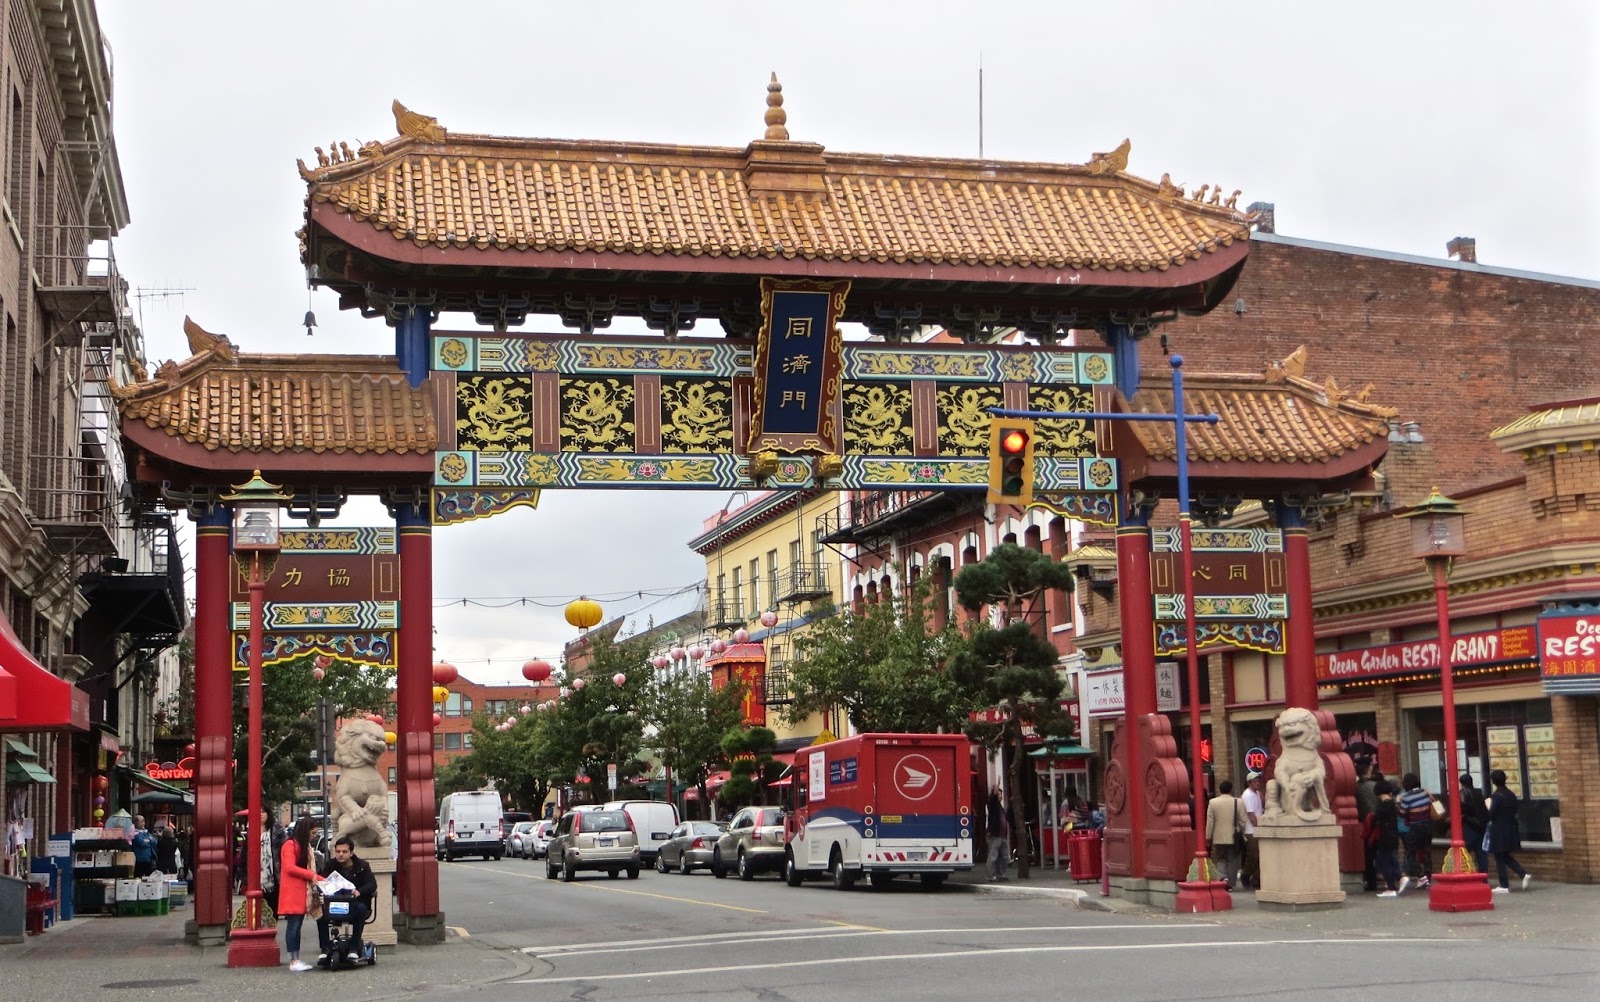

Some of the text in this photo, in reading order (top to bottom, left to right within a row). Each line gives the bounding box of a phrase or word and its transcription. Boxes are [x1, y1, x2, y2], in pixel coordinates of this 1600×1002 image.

[1329, 654, 1358, 675] Ocean
[1361, 648, 1399, 672] Garden
[1402, 635, 1497, 667] RESTRANT
